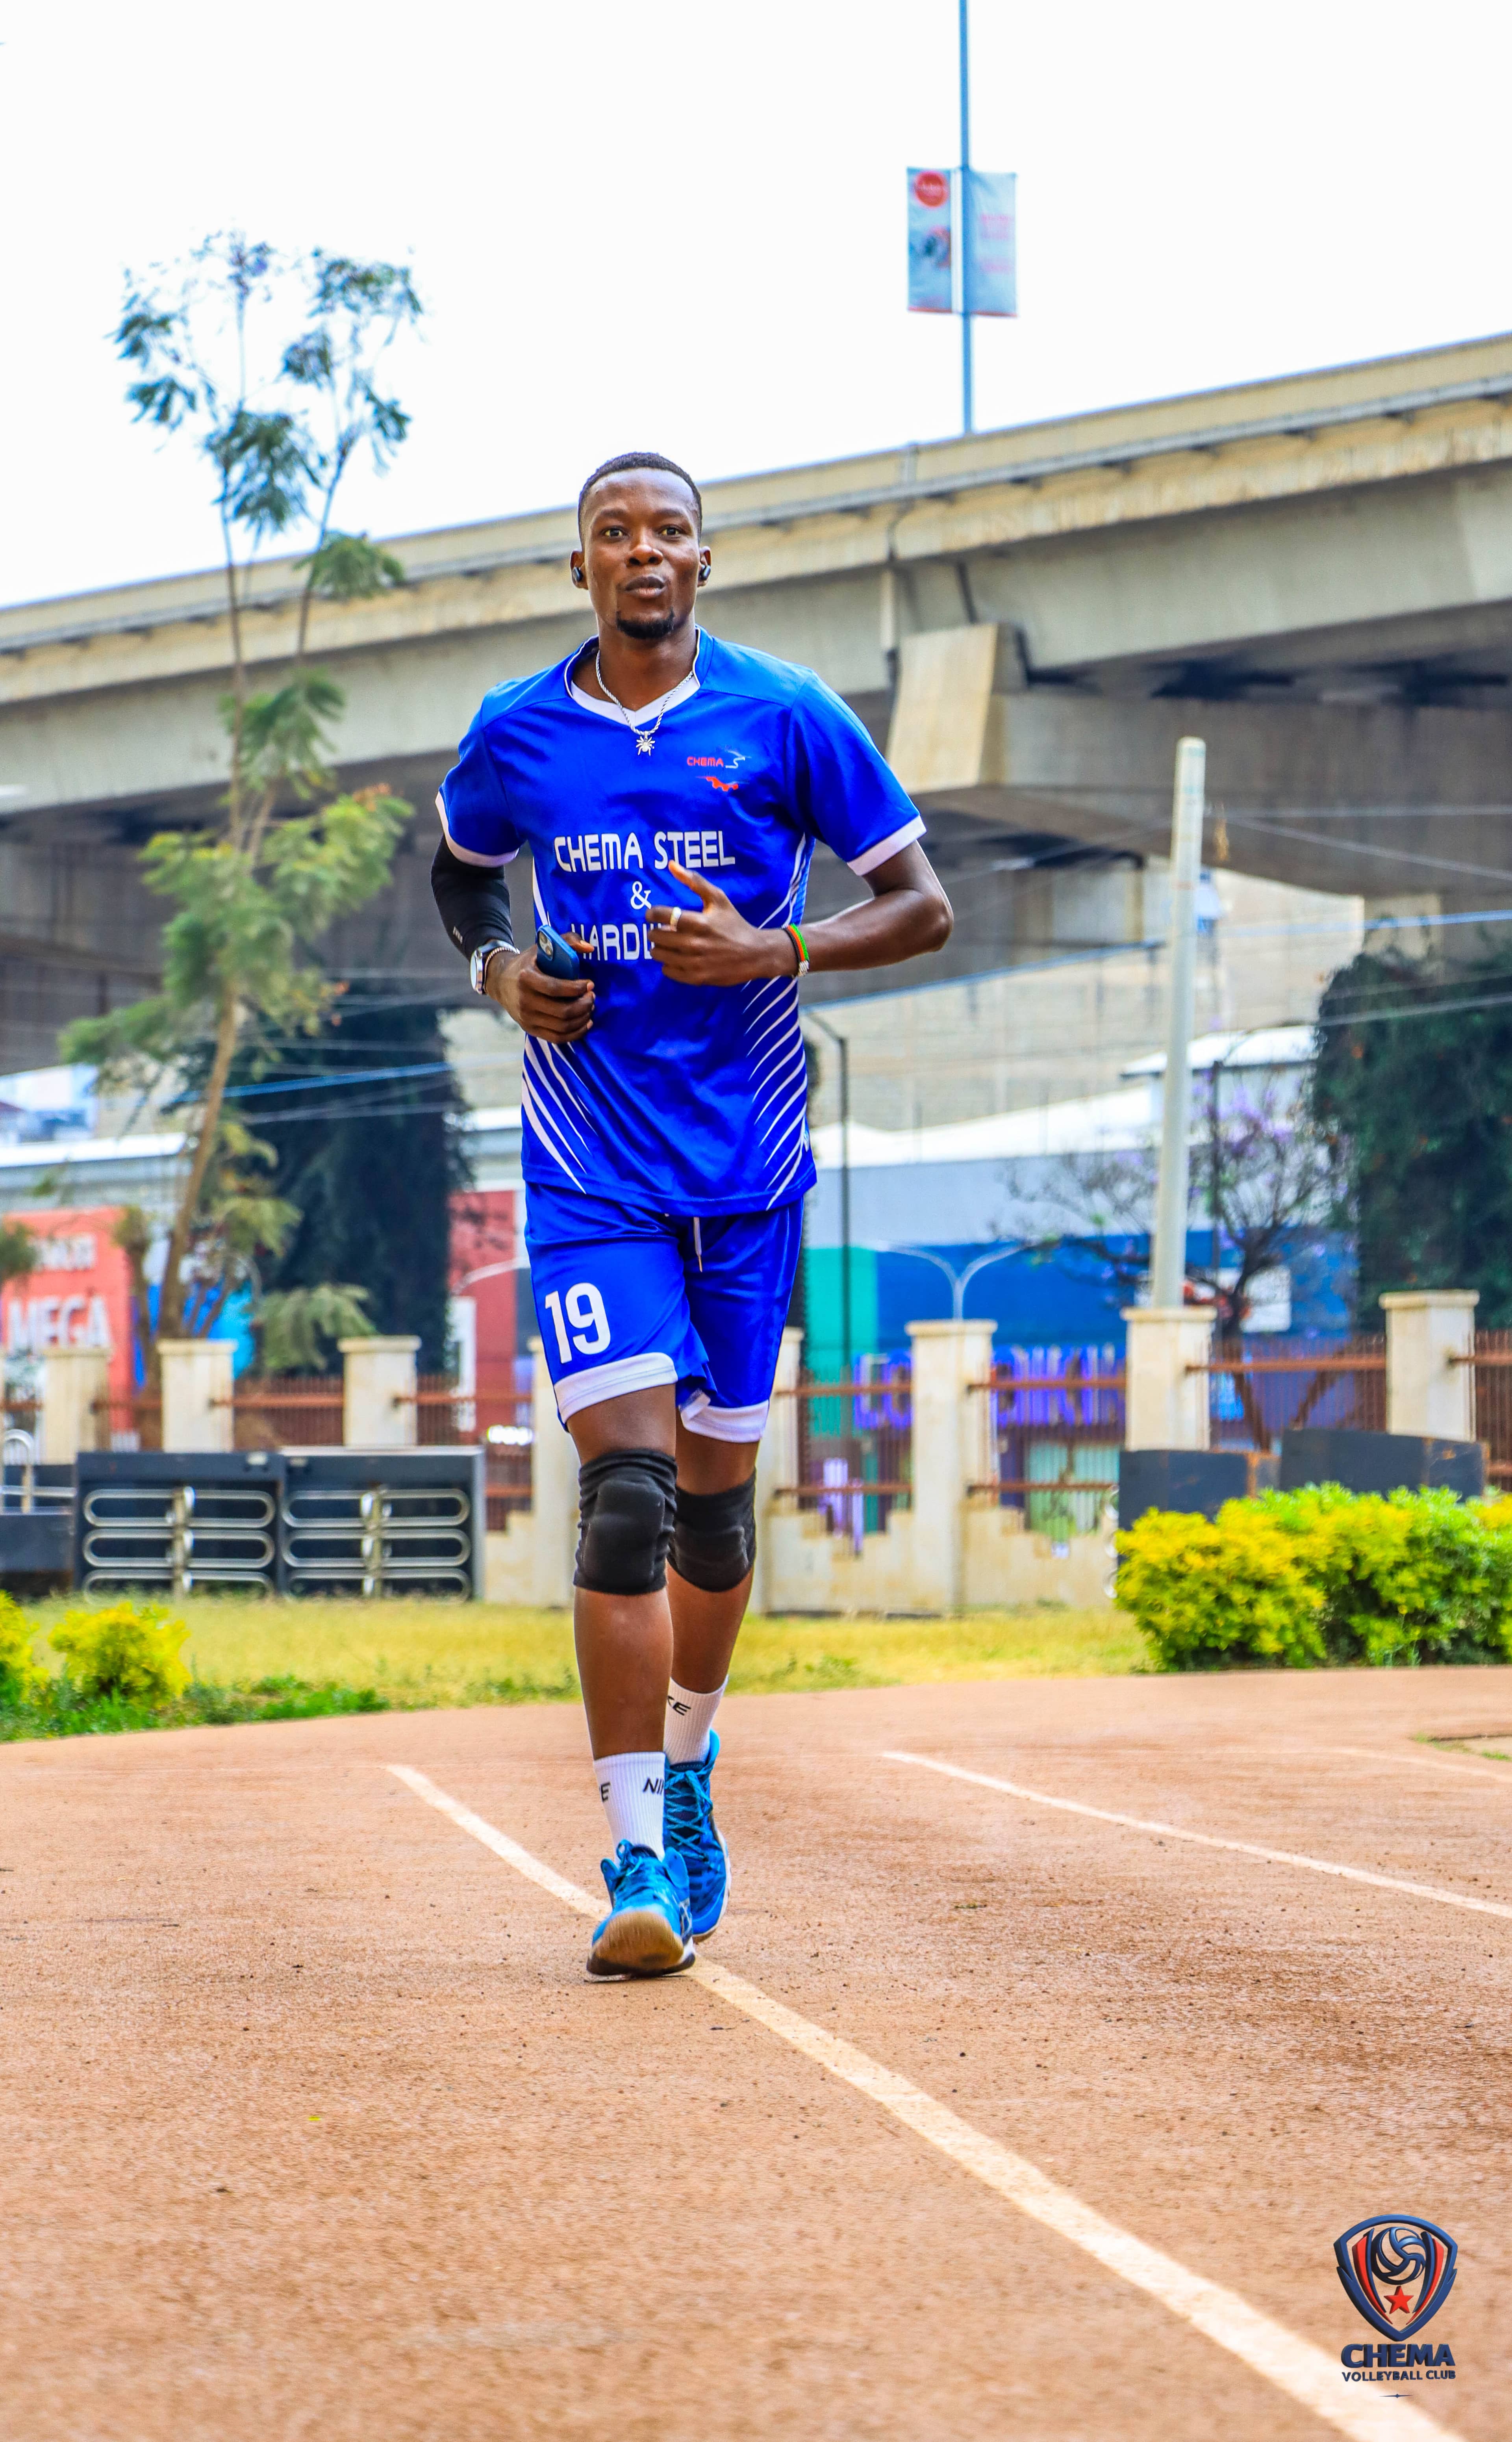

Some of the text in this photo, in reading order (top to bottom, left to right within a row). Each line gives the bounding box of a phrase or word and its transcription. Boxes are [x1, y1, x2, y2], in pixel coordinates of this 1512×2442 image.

[687, 756, 724, 768] CHEMA
[554, 830, 736, 872] CHEMA STEEL
[630, 881, 652, 910] &
[545, 1282, 611, 1364] 19
